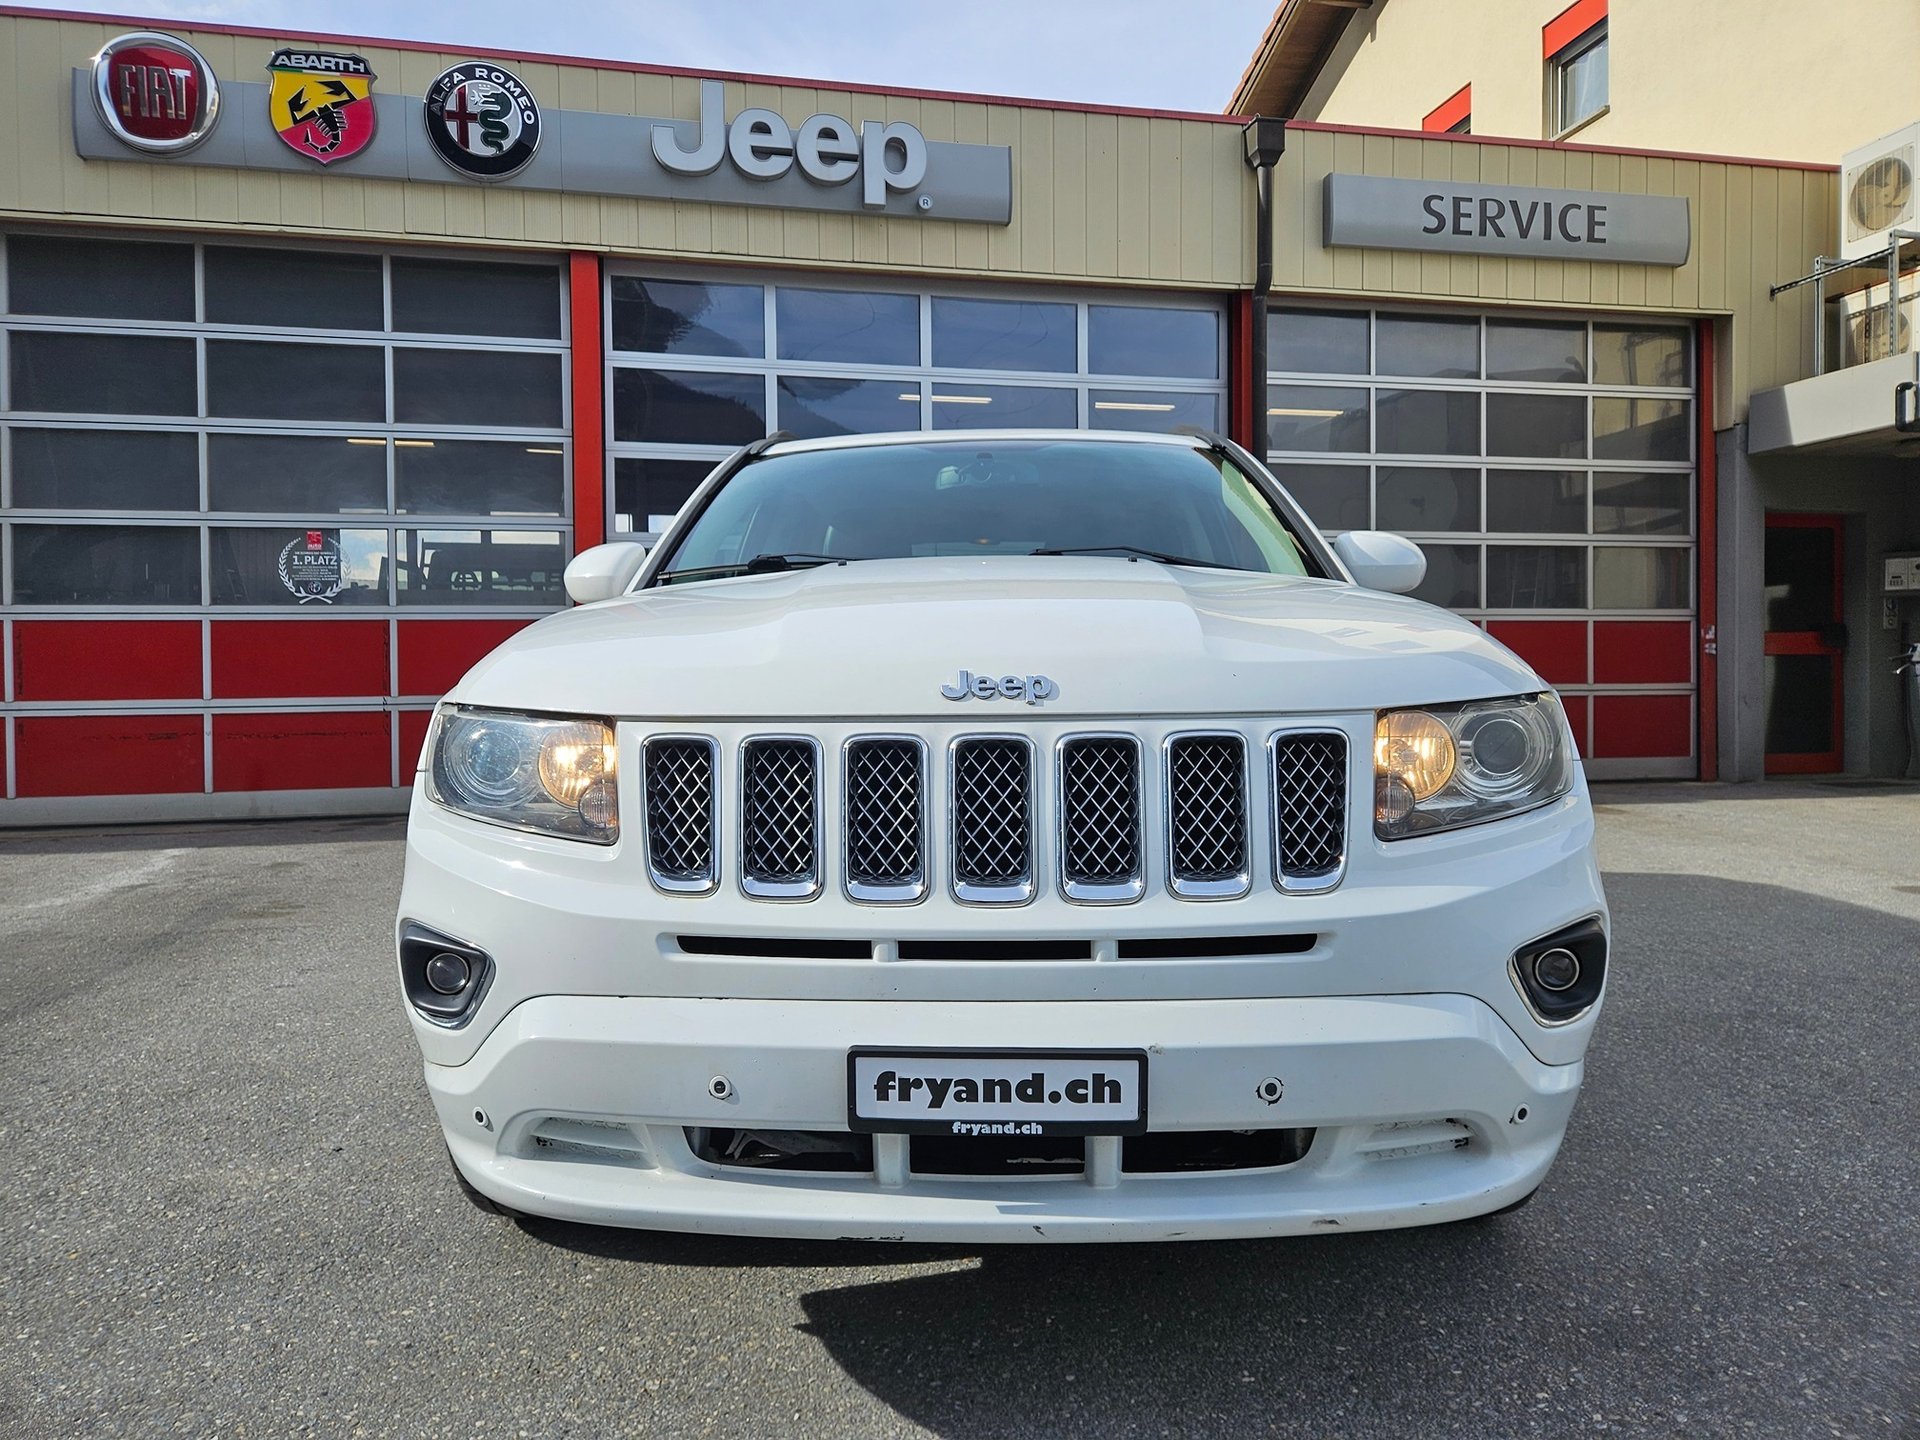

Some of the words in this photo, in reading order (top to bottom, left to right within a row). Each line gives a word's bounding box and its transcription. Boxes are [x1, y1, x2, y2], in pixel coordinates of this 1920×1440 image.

[274, 54, 365, 73] ABARTH
[117, 64, 192, 120] FIAT
[430, 71, 466, 117] ALFA
[475, 67, 535, 125] ROMEO
[650, 78, 928, 210] Jeep
[1422, 194, 1608, 244] SERVICE
[292, 555, 303, 565] 1.
[304, 555, 338, 566] PLATZ
[940, 669, 1053, 706] Jeep
[873, 1070, 1122, 1110] fryand.ch
[951, 1121, 1043, 1136] fryand.ch
